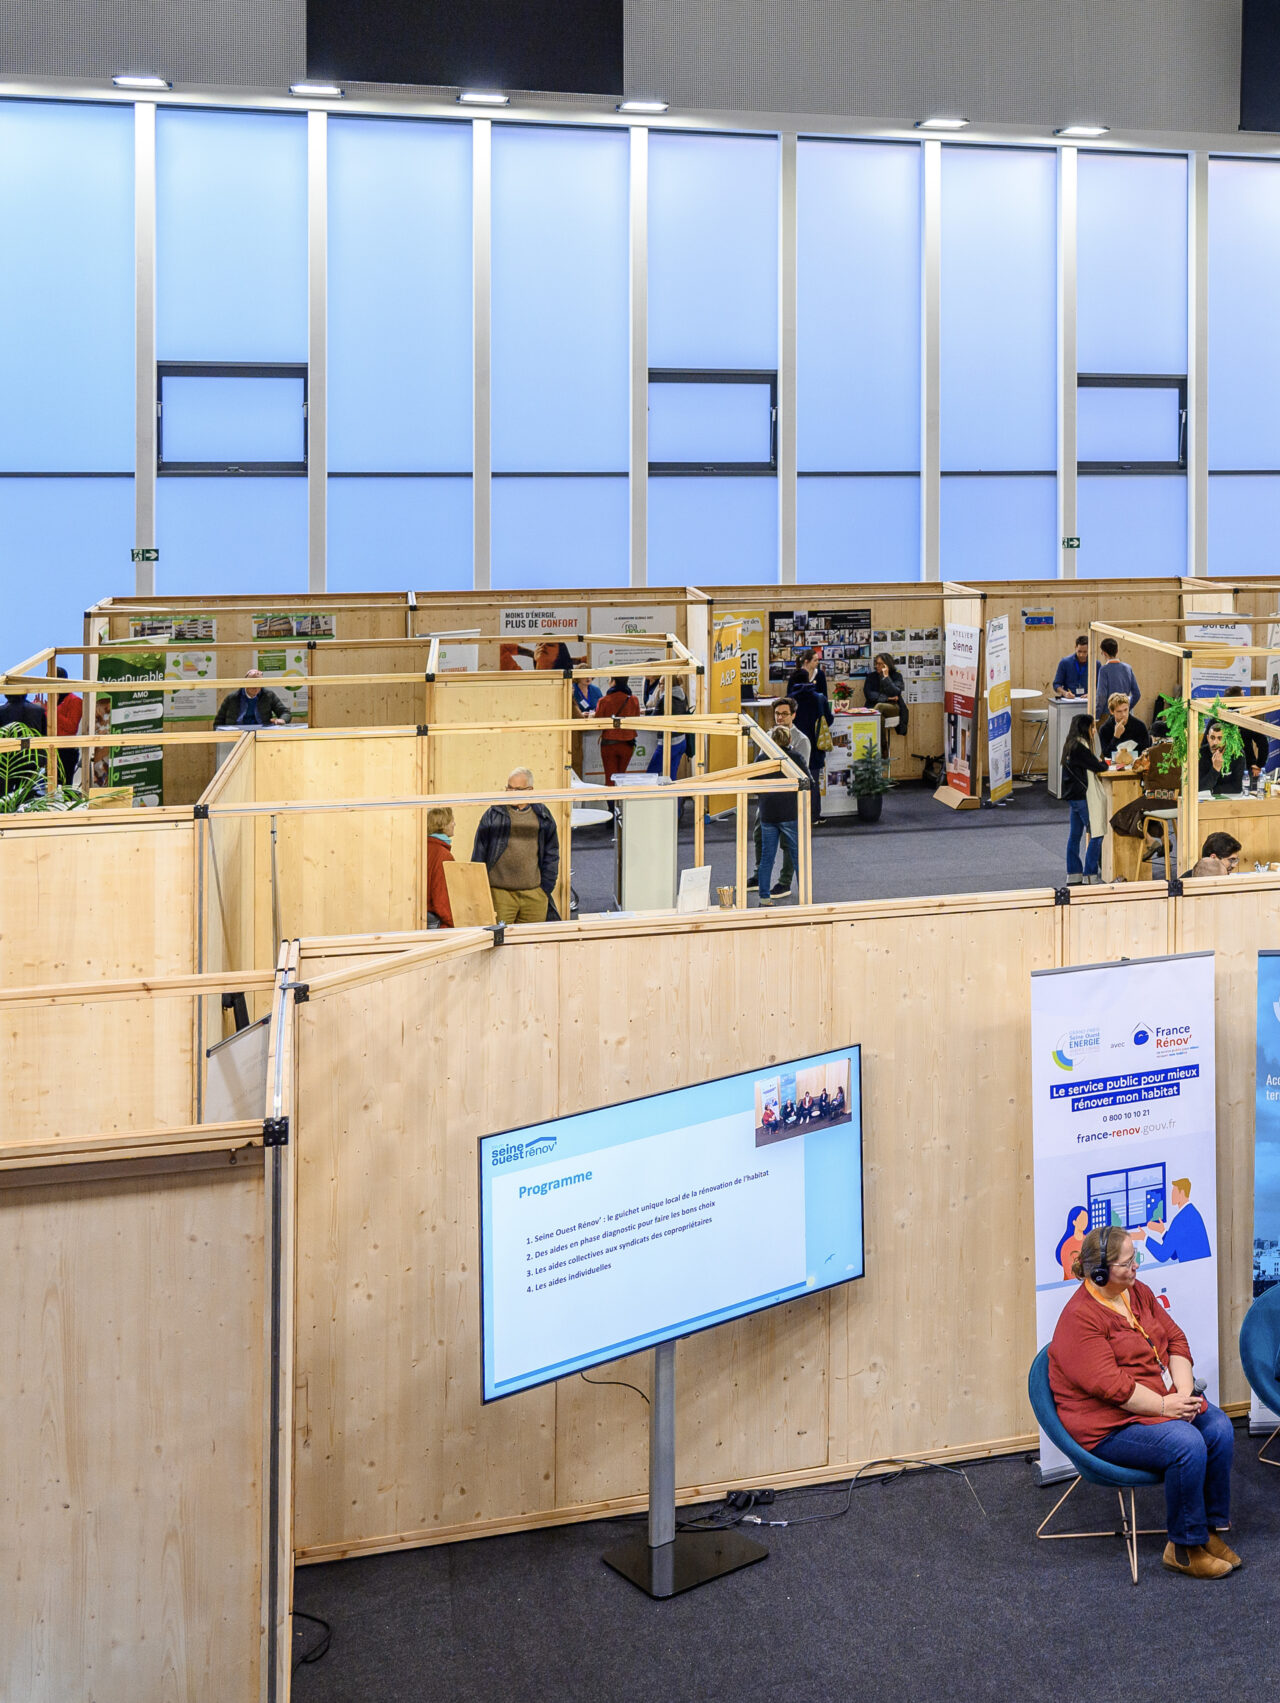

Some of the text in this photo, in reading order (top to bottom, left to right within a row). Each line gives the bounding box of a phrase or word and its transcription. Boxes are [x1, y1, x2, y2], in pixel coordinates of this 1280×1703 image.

[505, 618, 578, 628] PLUS DE CONFORT
[952, 630, 973, 639] ATELIER
[952, 640, 973, 653] sienne
[720, 668, 736, 687] A&P
[132, 691, 148, 699] AMO
[1156, 1025, 1190, 1037] France
[1069, 1037, 1100, 1048] ENERGIE
[1110, 1041, 1125, 1049] avec
[1156, 1034, 1192, 1048] Rénov'
[1053, 1067, 1198, 1097] Le service public pour mieux
[1074, 1085, 1178, 1110] rénover mon habitat
[1109, 1113, 1122, 1122] 800
[1133, 1110, 1141, 1118] 10
[1077, 1118, 1176, 1144] france-renov.gouv.fr
[491, 1143, 524, 1159] seine
[491, 1150, 524, 1166] ouest
[519, 1170, 593, 1199] Programme
[526, 1237, 533, 1245] 1.
[534, 1232, 554, 1243] Seine
[555, 1225, 576, 1236] Ouest
[614, 1206, 639, 1221] guichet
[641, 1200, 664, 1212] unique
[665, 1194, 680, 1205] local
[681, 1192, 690, 1200] de
[699, 1180, 733, 1195] rénovation
[734, 1177, 742, 1185] de
[743, 1169, 769, 1182] l'habitat
[526, 1253, 533, 1261] 2.
[535, 1248, 548, 1259] Des
[549, 1244, 568, 1254] aides
[580, 1233, 600, 1247] phase
[602, 1223, 636, 1239] diagnostic
[637, 1219, 653, 1230] pour
[654, 1214, 670, 1223] faire
[670, 1210, 680, 1219] les
[681, 1206, 697, 1216] bons
[698, 1200, 716, 1211] choix
[526, 1216, 713, 1277] 3. Les aides collectives aux syndicats des copropriétaires
[535, 1281, 547, 1291] Les
[548, 1276, 567, 1287] aides
[568, 1262, 612, 1280] individuelles
